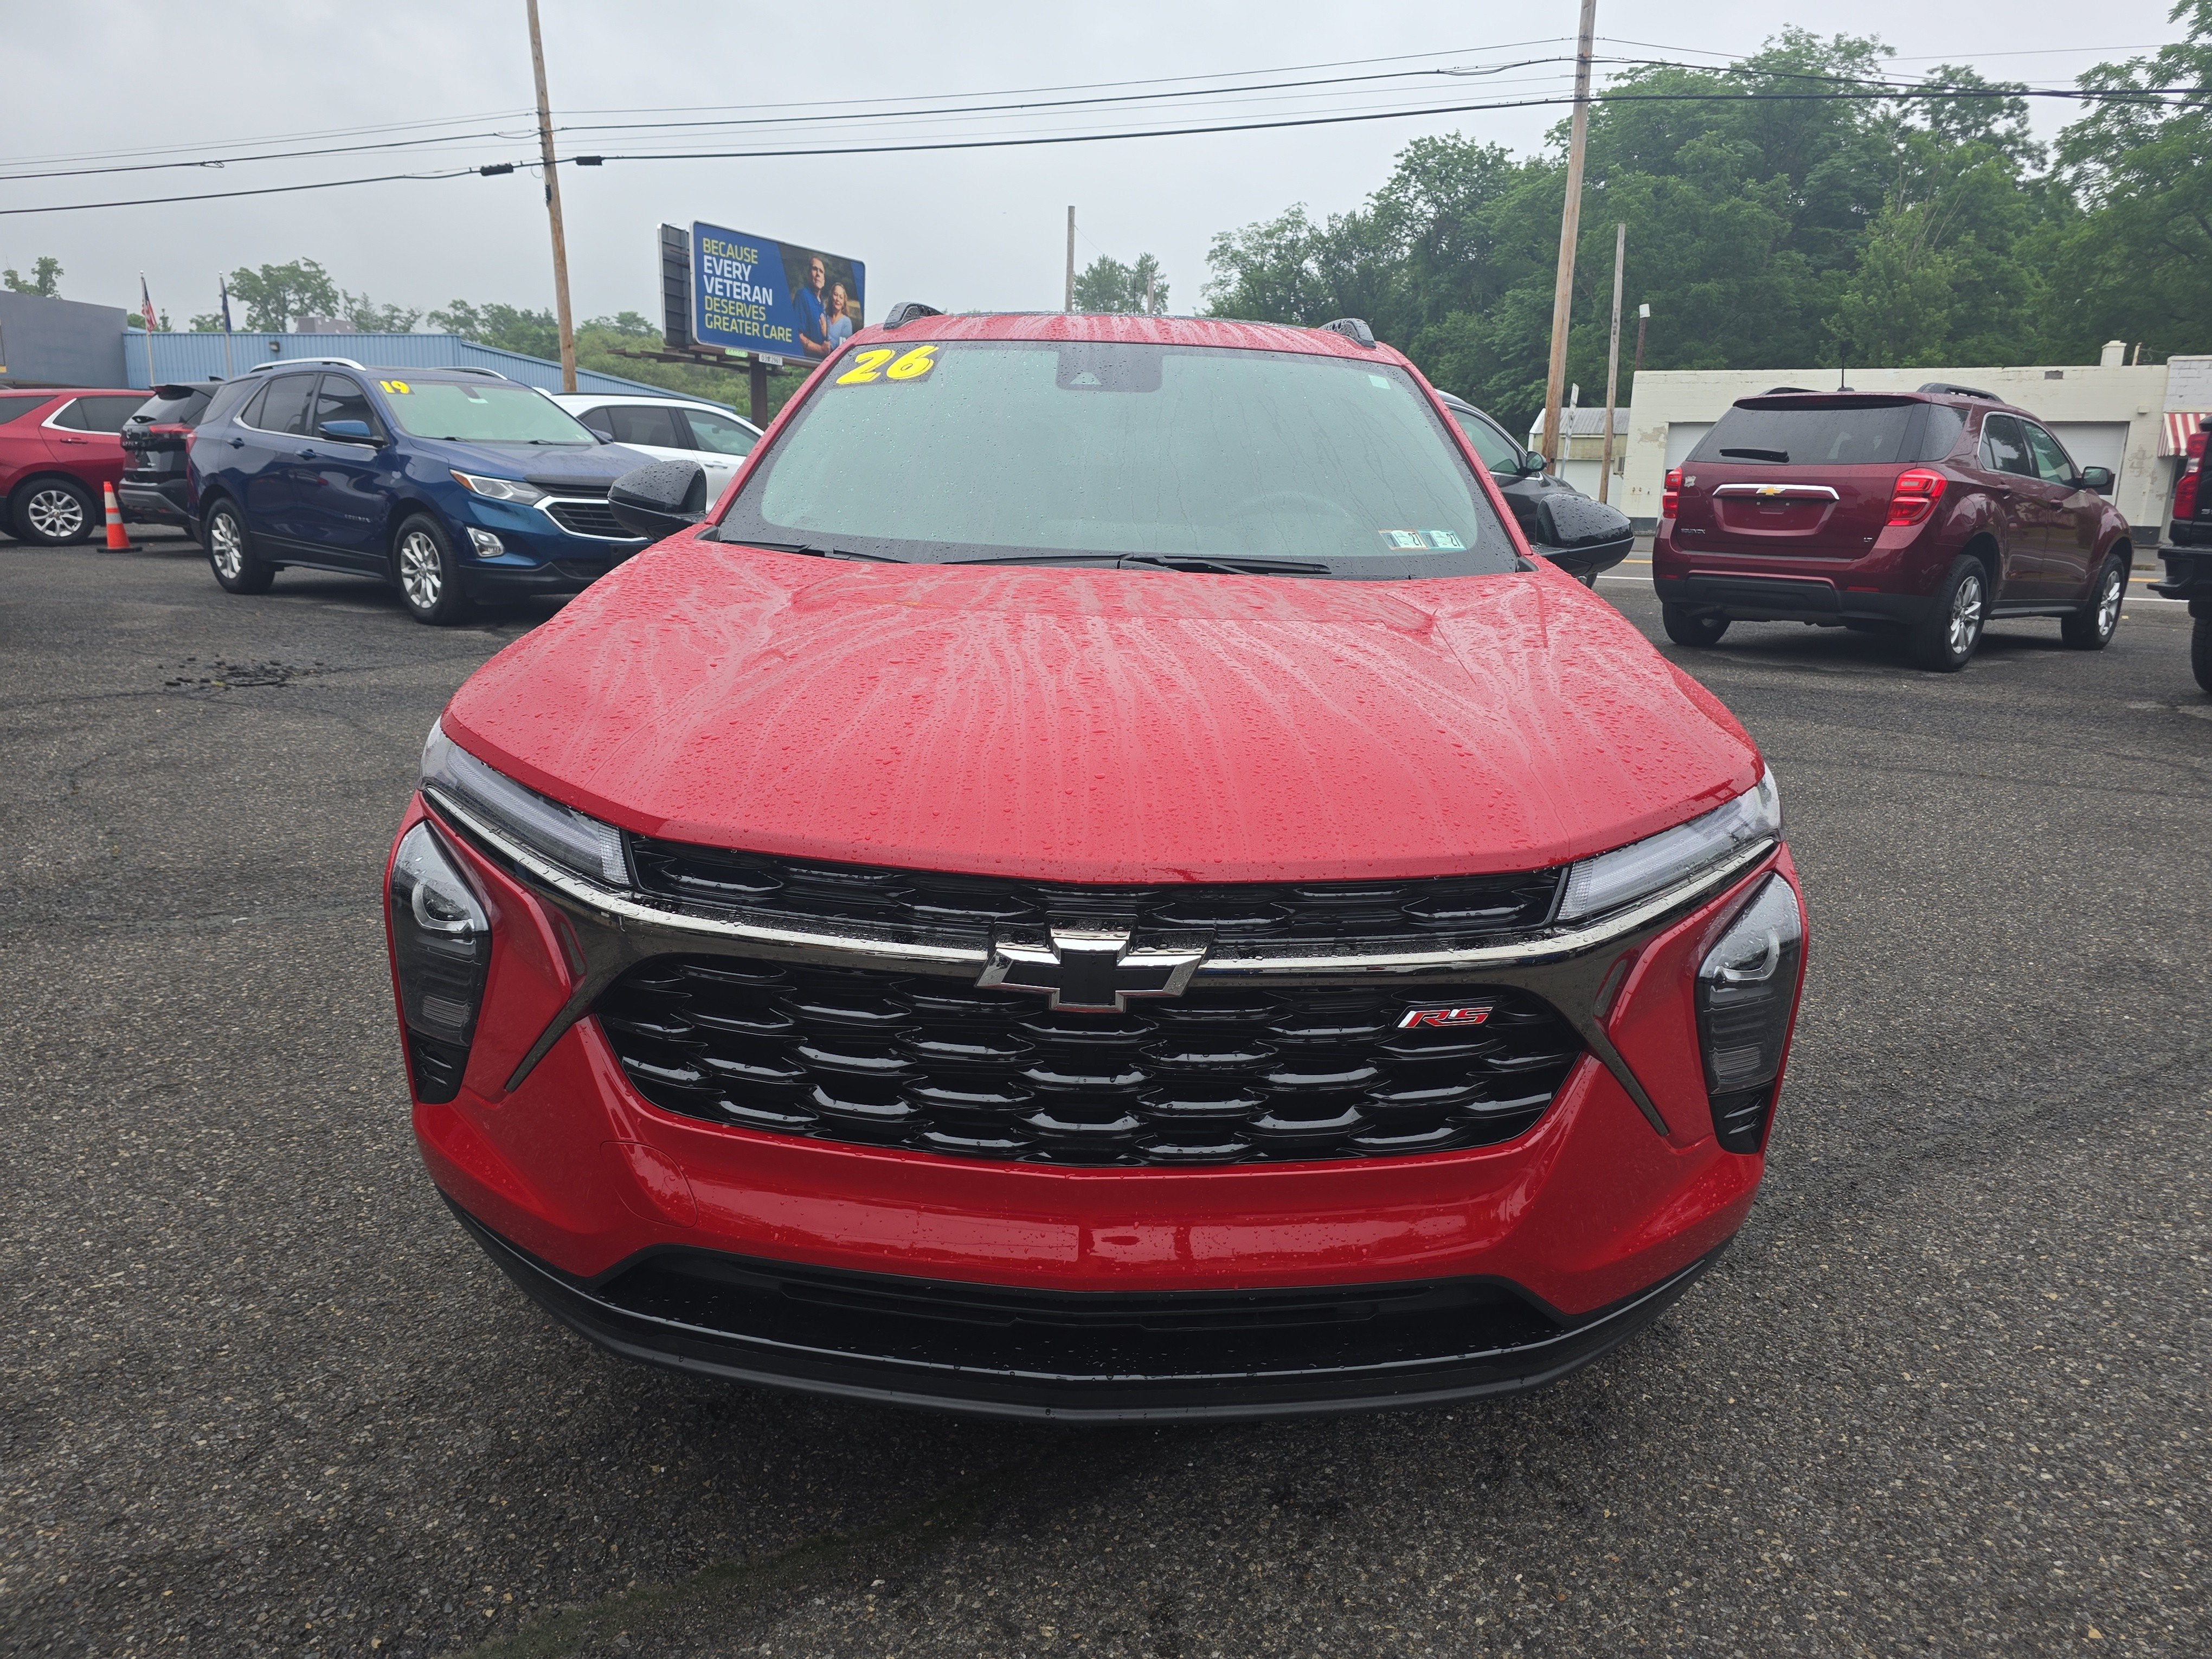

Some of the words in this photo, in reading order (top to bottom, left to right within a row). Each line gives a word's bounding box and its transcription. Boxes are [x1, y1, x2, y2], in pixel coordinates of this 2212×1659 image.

[703, 237, 758, 264] BECAUSE
[703, 255, 751, 281] EVERY
[703, 275, 773, 306] VETERAN
[705, 295, 766, 321] DESERVES
[705, 313, 760, 337] GREATER
[762, 324, 792, 343] CARE
[835, 345, 940, 385] 26
[380, 380, 410, 394] 19
[1408, 533, 1423, 547] 27
[1446, 533, 1461, 548] 27
[1398, 1007, 1493, 1028] RS
